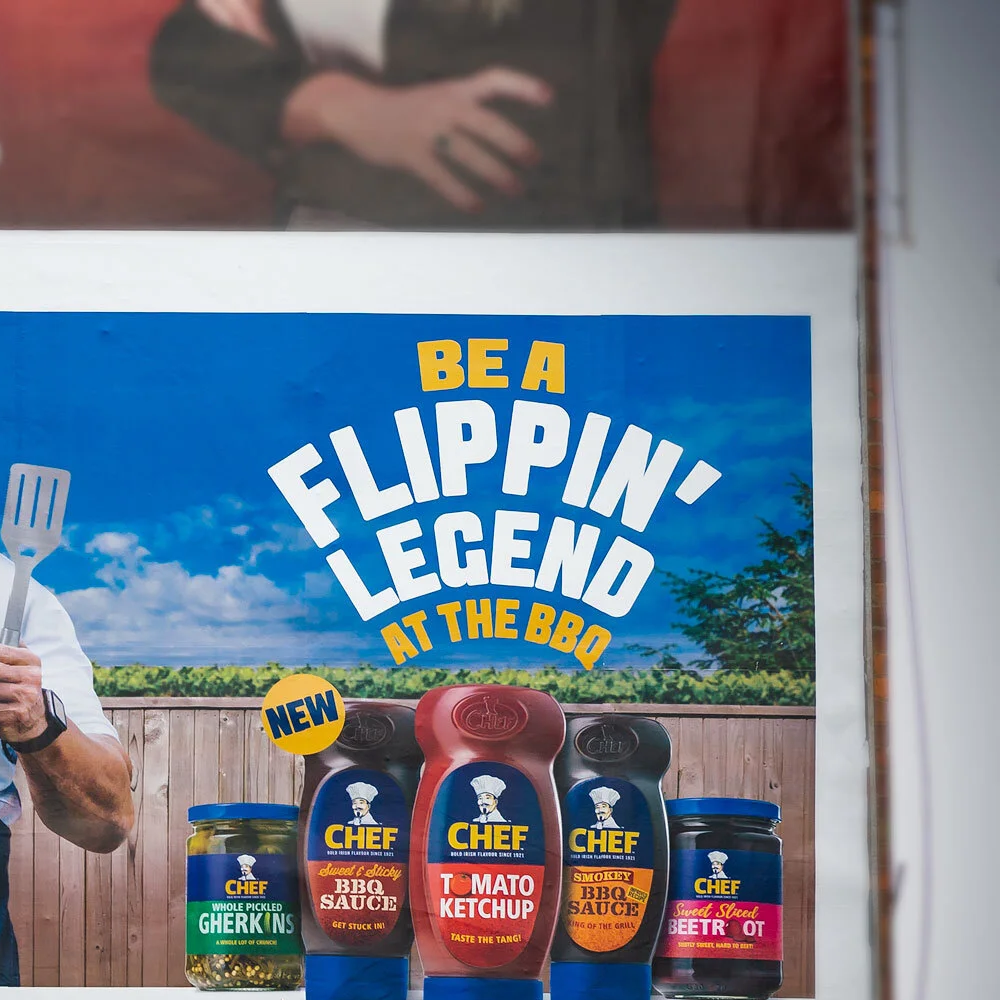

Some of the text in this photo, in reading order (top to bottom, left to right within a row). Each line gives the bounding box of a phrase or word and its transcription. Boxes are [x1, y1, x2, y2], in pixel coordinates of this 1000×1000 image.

[417, 338, 565, 394] BE A
[267, 399, 722, 549] FLIPPIN'
[325, 509, 655, 622] LEGEND
[380, 598, 612, 671] AT THE BBQ
[265, 689, 340, 740] NEW
[324, 823, 399, 850] CHEF
[448, 821, 529, 850] CHEF
[568, 828, 640, 854] CHEF
[318, 863, 354, 877] Sweet
[365, 864, 402, 881] Sticky
[573, 870, 632, 883] SMOKEY
[225, 879, 268, 895] CHEF
[334, 878, 385, 895] BBQ
[580, 886, 627, 901] BBQ
[694, 877, 741, 895] CHEF
[212, 902, 283, 912] WHOLE PICKLED
[320, 894, 397, 911] SAUCE
[440, 898, 534, 920] KETCHUP
[567, 900, 639, 917] SAUCE
[673, 902, 759, 919] Sweet Sliced
[198, 912, 295, 935] GHERKINS
[332, 920, 347, 929] GET
[348, 922, 372, 930] STUCK
[587, 922, 597, 930] OF
[599, 922, 612, 930] THE
[614, 922, 636, 930] GRILL
[450, 933, 522, 944] TASTE THE TANG!
